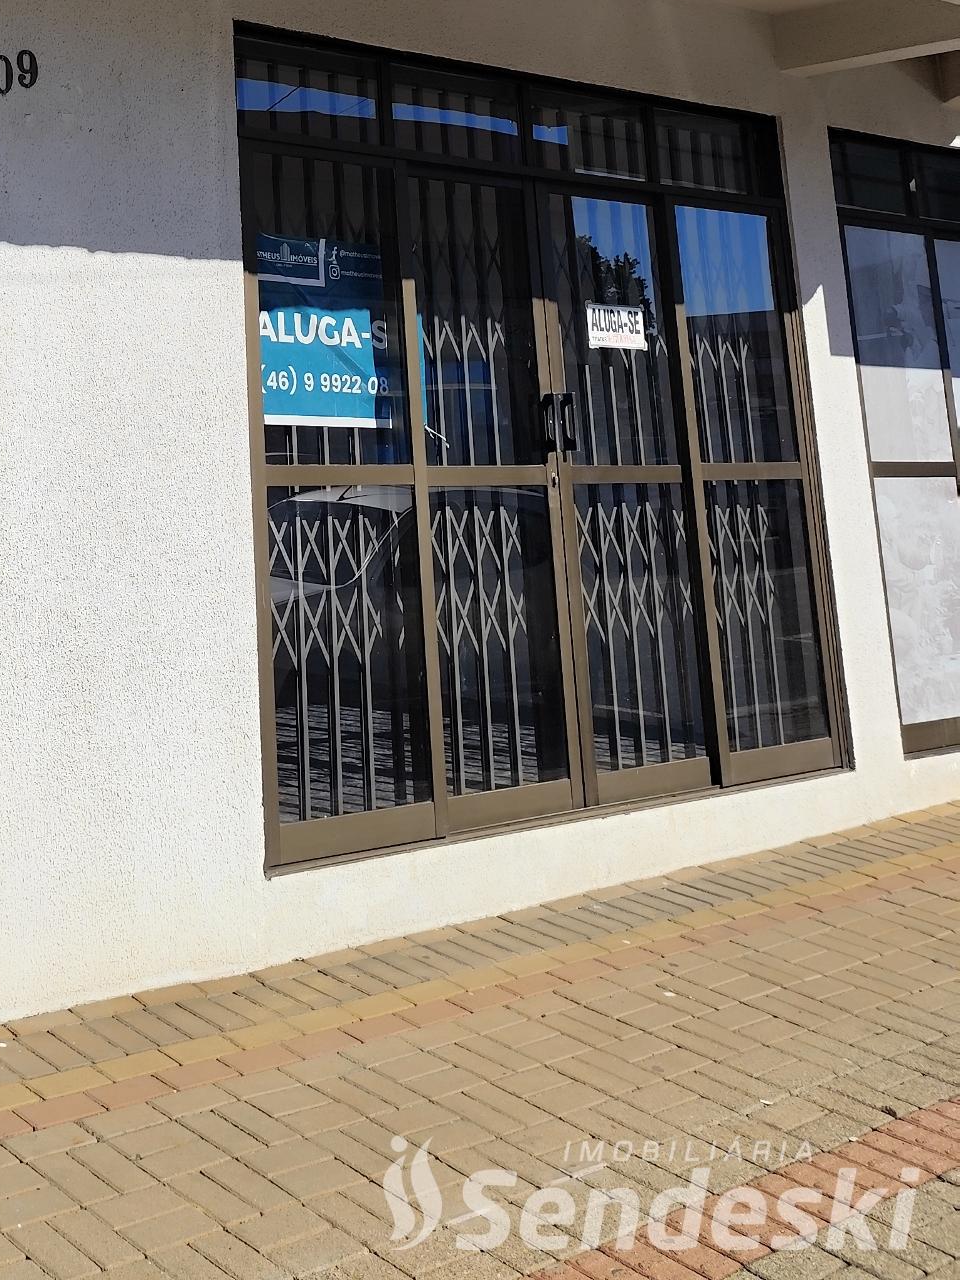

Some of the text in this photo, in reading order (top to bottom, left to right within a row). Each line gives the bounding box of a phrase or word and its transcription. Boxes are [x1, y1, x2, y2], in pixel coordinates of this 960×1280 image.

[290, 253, 318, 264] IMÓVEIS
[591, 308, 641, 335] ALUGA-SE
[260, 364, 297, 395] (46)
[303, 372, 314, 392] 9
[320, 373, 362, 394] 9922
